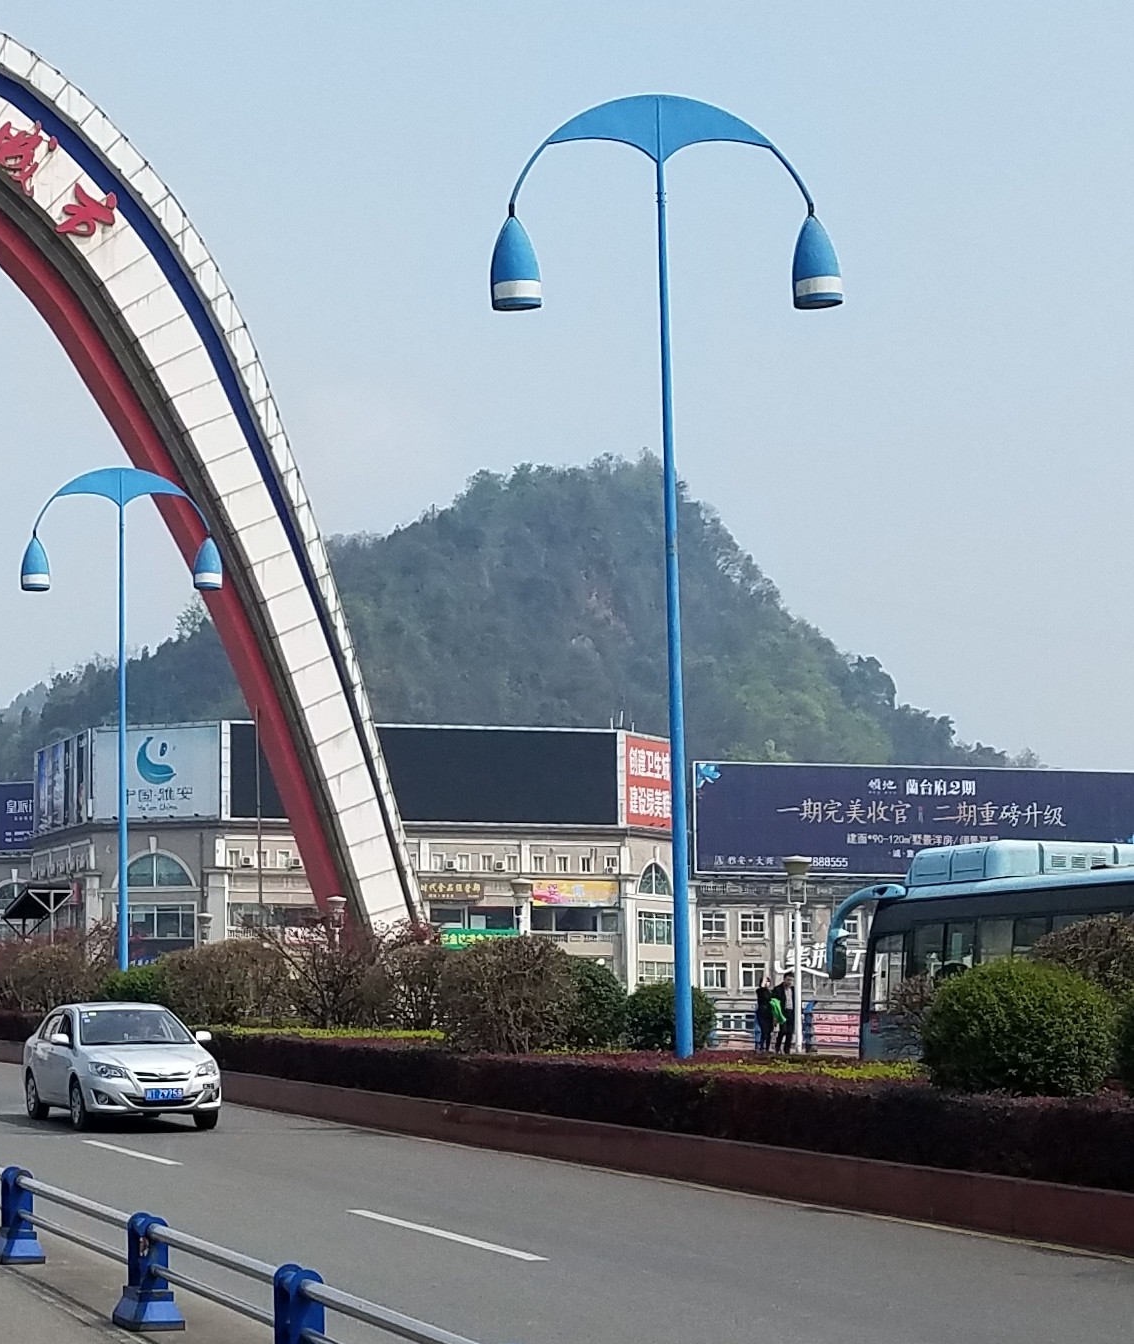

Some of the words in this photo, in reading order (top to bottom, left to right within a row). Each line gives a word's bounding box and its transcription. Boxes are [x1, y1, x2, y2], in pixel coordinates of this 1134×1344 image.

[776, 798, 912, 824] 一期完美收官
[932, 800, 1067, 827] 二期重磅升级
[809, 856, 849, 867] 888555
